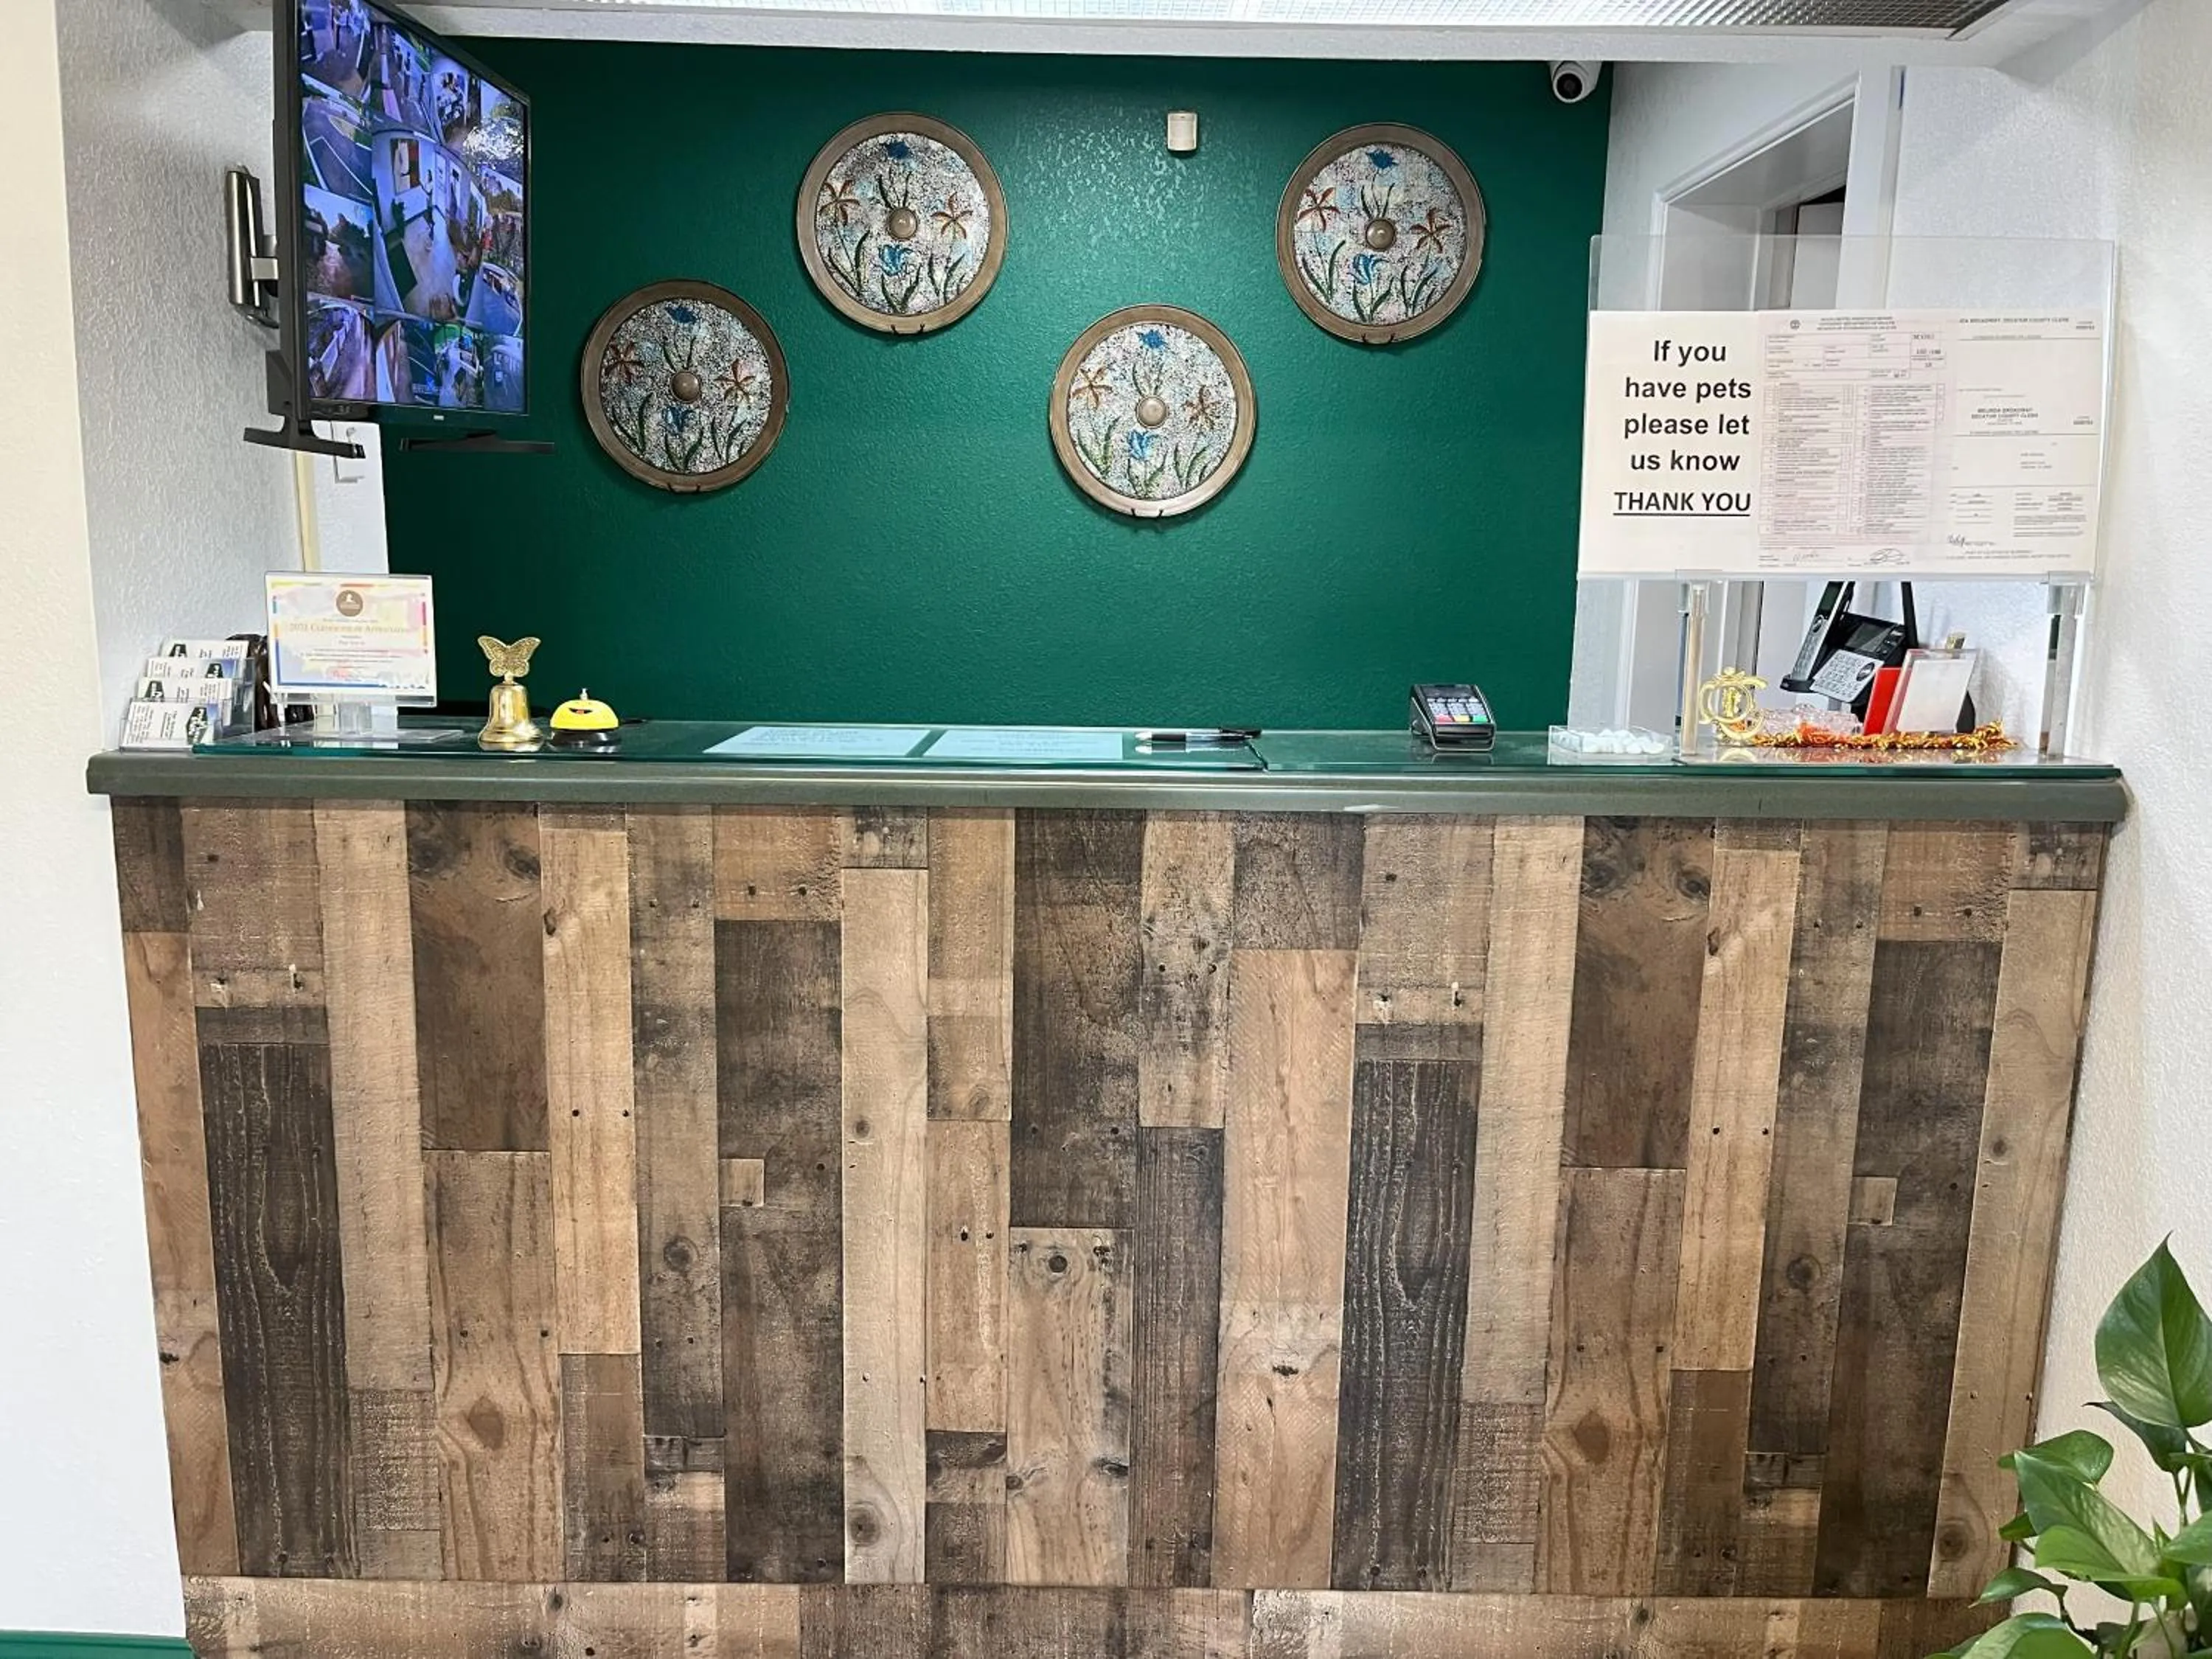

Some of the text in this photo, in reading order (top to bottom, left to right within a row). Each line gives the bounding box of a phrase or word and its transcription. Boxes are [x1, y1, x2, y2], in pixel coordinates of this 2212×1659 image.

[1654, 340, 1726, 367] If you
[1625, 377, 1751, 403] have pets
[1624, 413, 1750, 439] please let
[1631, 449, 1741, 470] us know
[1613, 492, 1751, 512] THANK YOU
